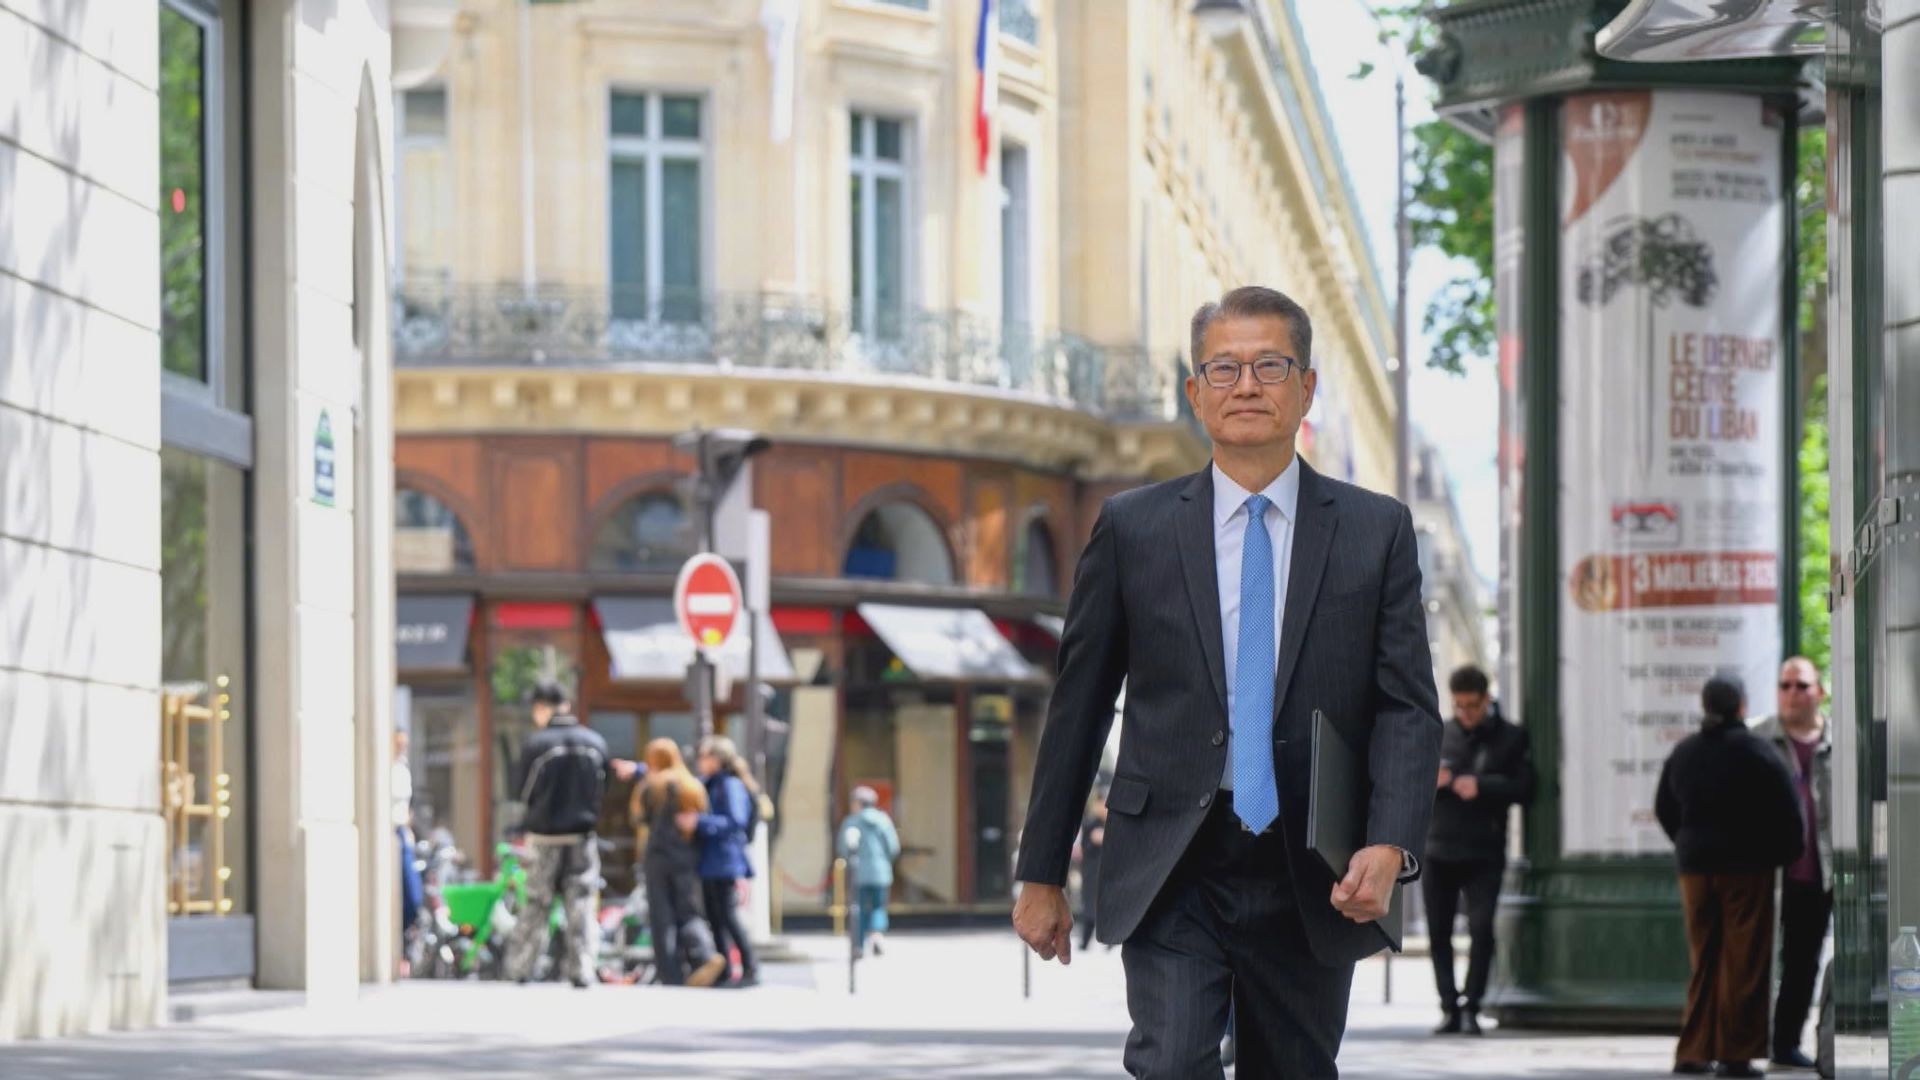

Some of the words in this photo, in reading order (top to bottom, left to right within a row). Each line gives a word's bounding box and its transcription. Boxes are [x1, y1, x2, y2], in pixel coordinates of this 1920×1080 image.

[1669, 332, 1696, 365] LE
[1669, 405, 1700, 438] DU
[1631, 556, 1650, 592] 3
